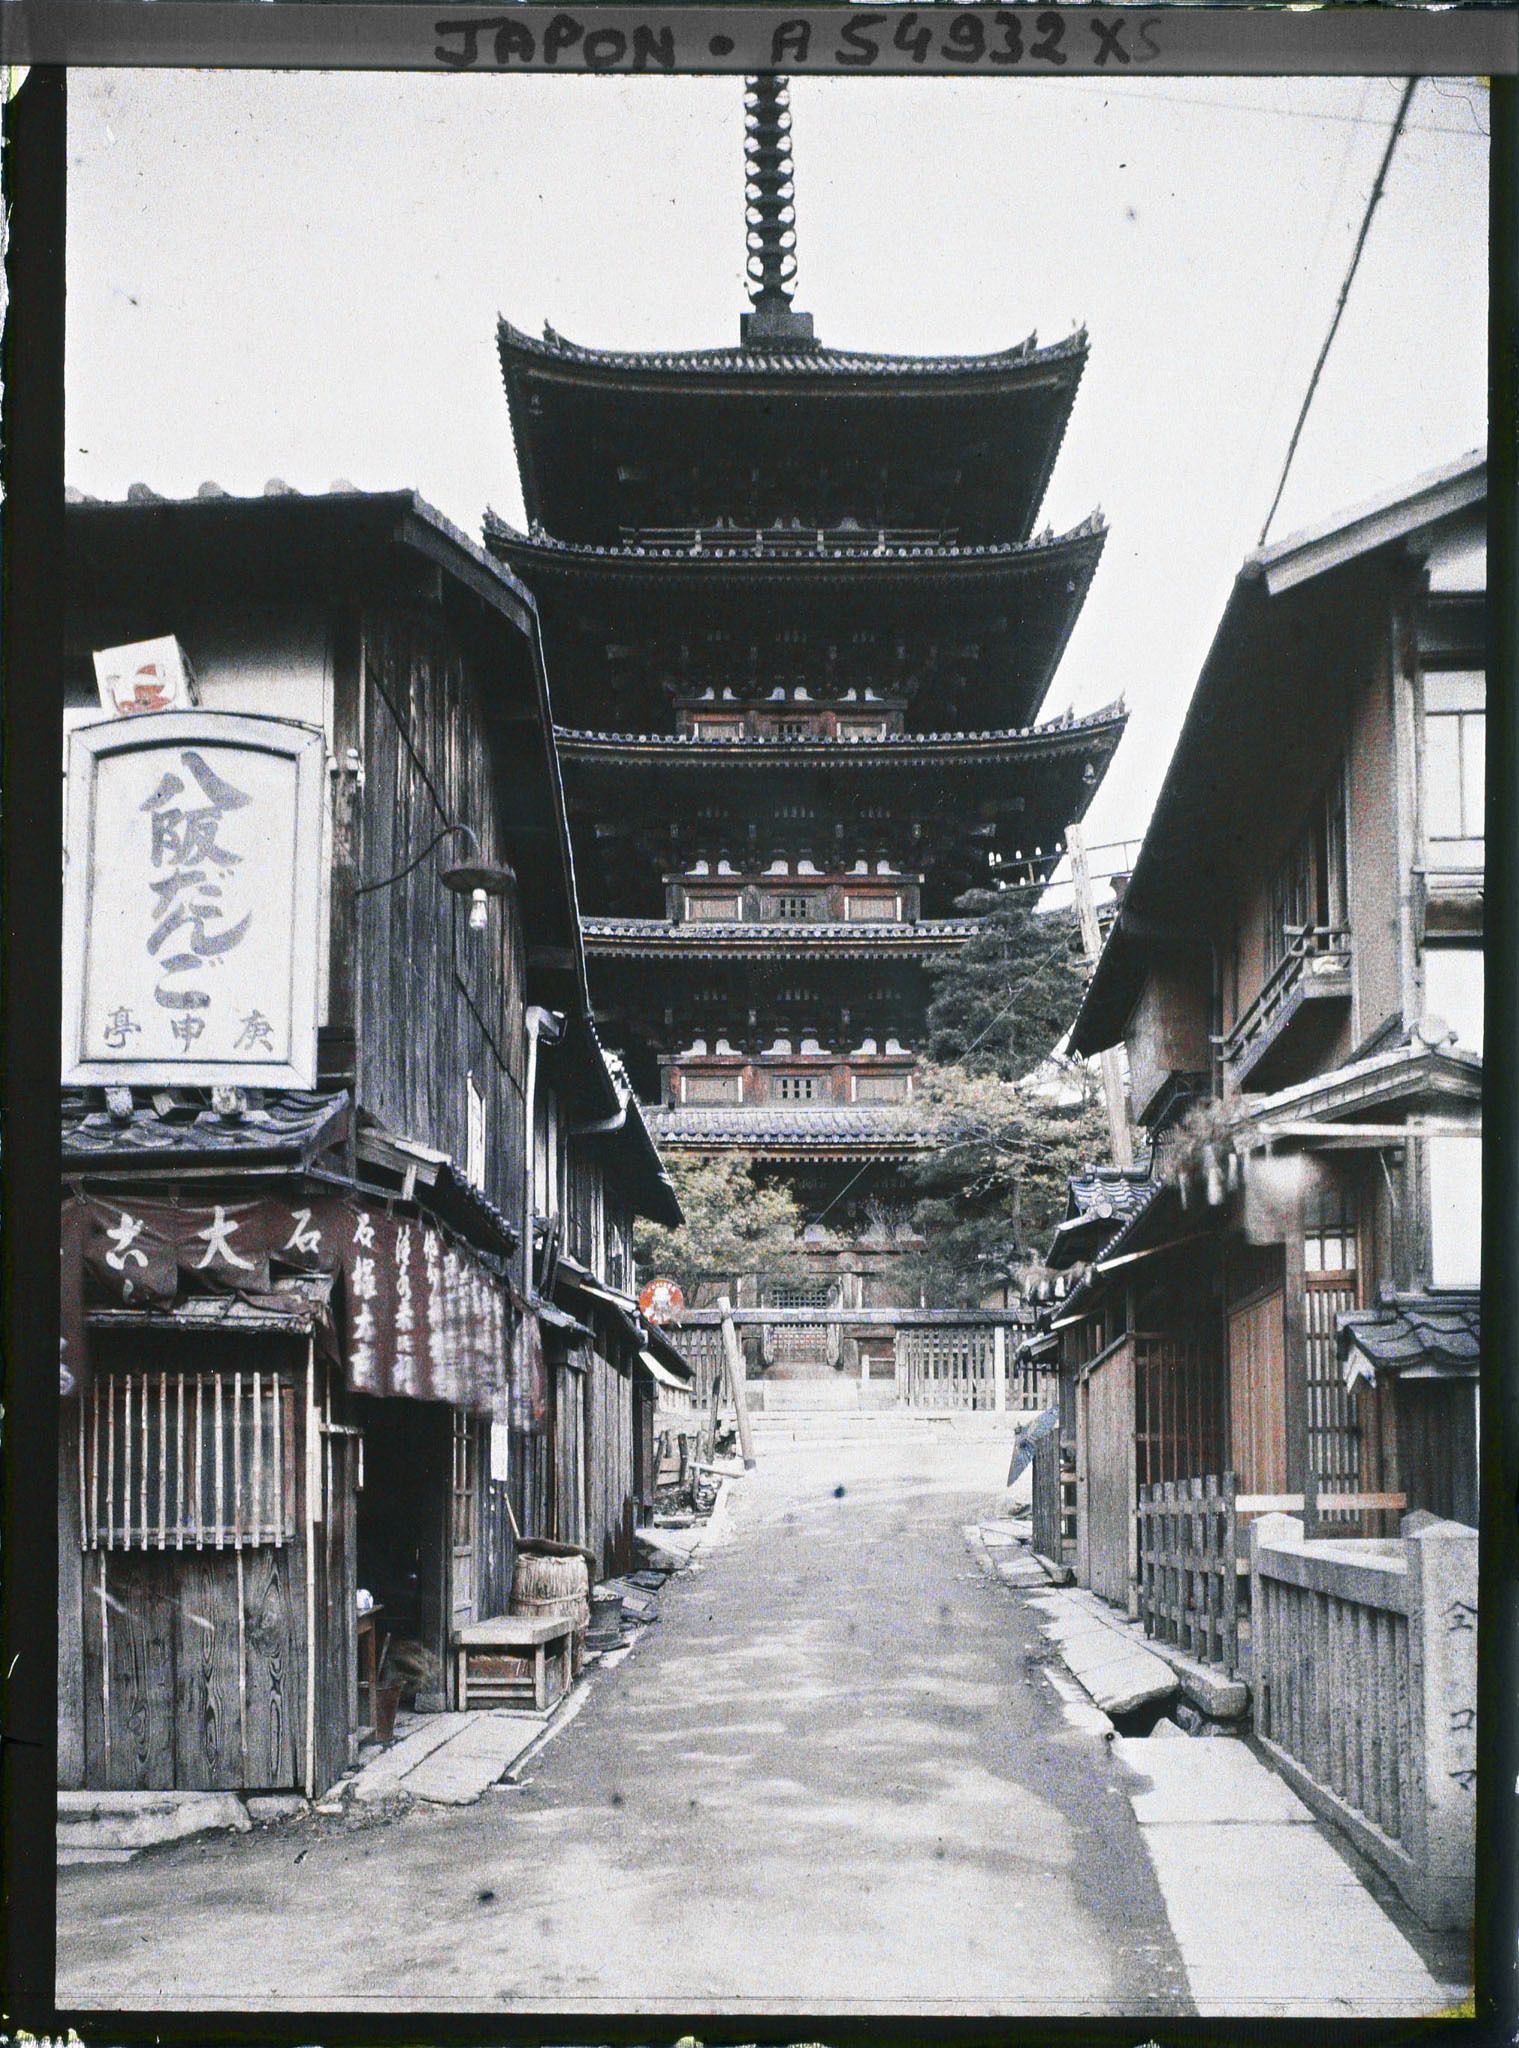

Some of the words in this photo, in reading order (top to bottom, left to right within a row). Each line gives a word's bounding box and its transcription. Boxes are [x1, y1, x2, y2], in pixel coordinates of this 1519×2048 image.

[140, 750, 254, 1010] 八阪だんご
